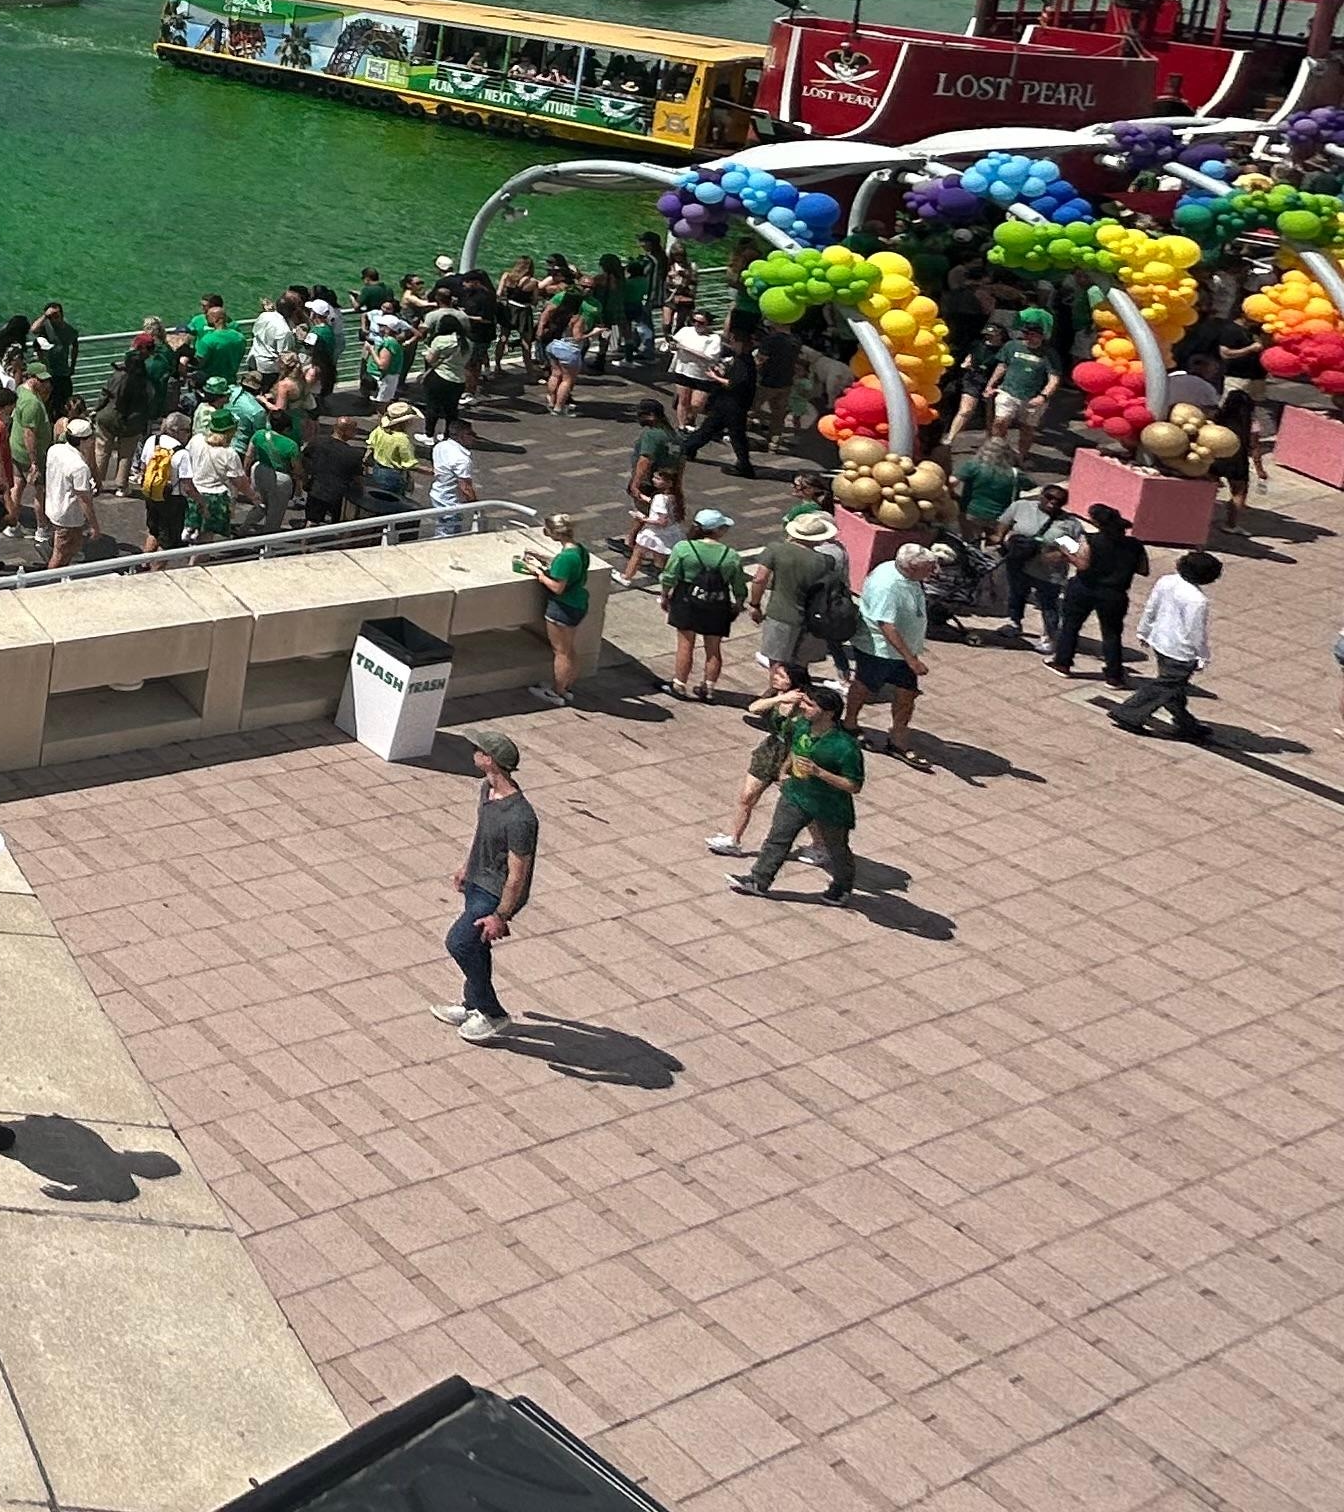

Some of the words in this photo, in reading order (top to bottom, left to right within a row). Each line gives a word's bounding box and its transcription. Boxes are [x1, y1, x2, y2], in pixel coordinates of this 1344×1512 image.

[485, 89, 512, 104] NEXT
[801, 85, 836, 100] LOST
[837, 91, 879, 109] PEARL
[933, 72, 1012, 101] LOST
[1018, 80, 1096, 111] PEARL
[356, 652, 404, 692] TRASH
[408, 678, 446, 694] TRASH
